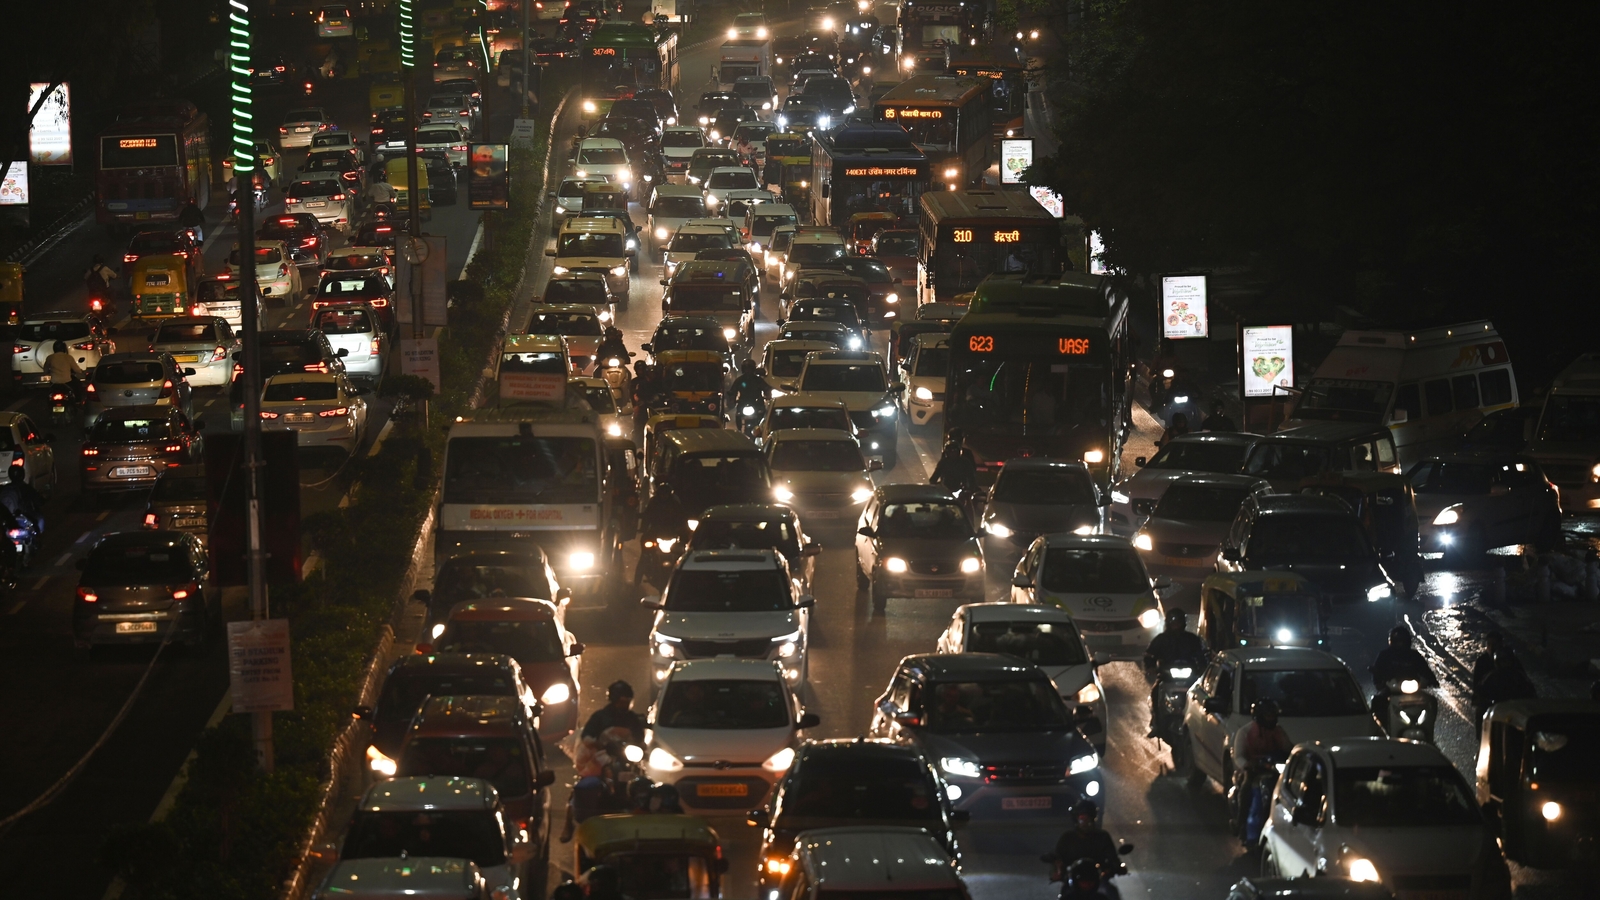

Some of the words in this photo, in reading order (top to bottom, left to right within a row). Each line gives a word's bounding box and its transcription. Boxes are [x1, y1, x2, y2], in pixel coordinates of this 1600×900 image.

[908, 5, 963, 13] TOURIST
[885, 109, 895, 118] 85
[954, 230, 972, 242] 310
[994, 230, 1020, 242] इंद्रपुरी
[969, 336, 993, 351] 623
[469, 509, 493, 520] MEDICAL
[493, 510, 515, 520] OXYGEN
[526, 510, 538, 520] FOR
[538, 510, 563, 521] HOSPITAL
[247, 646, 286, 656] STADIUM
[243, 656, 280, 666] PARKING
